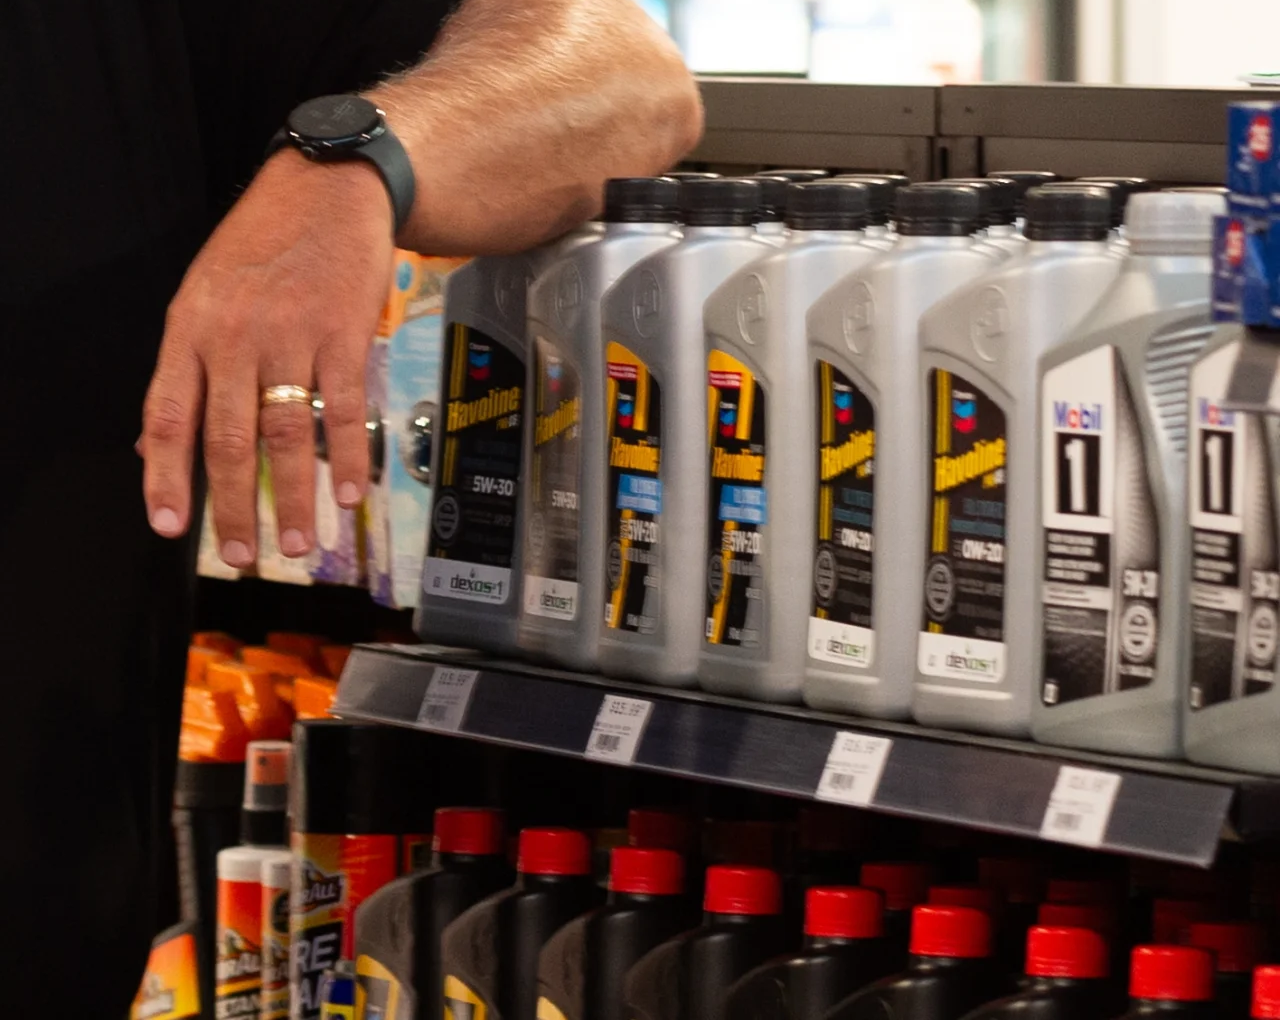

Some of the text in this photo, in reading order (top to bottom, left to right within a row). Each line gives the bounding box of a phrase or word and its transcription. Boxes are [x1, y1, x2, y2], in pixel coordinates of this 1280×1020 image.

[447, 387, 520, 433] Havoline
[1054, 401, 1102, 429] Mobil
[472, 475, 514, 496] 5W-30
[1065, 438, 1087, 513] 1
[1206, 435, 1224, 510] 1
